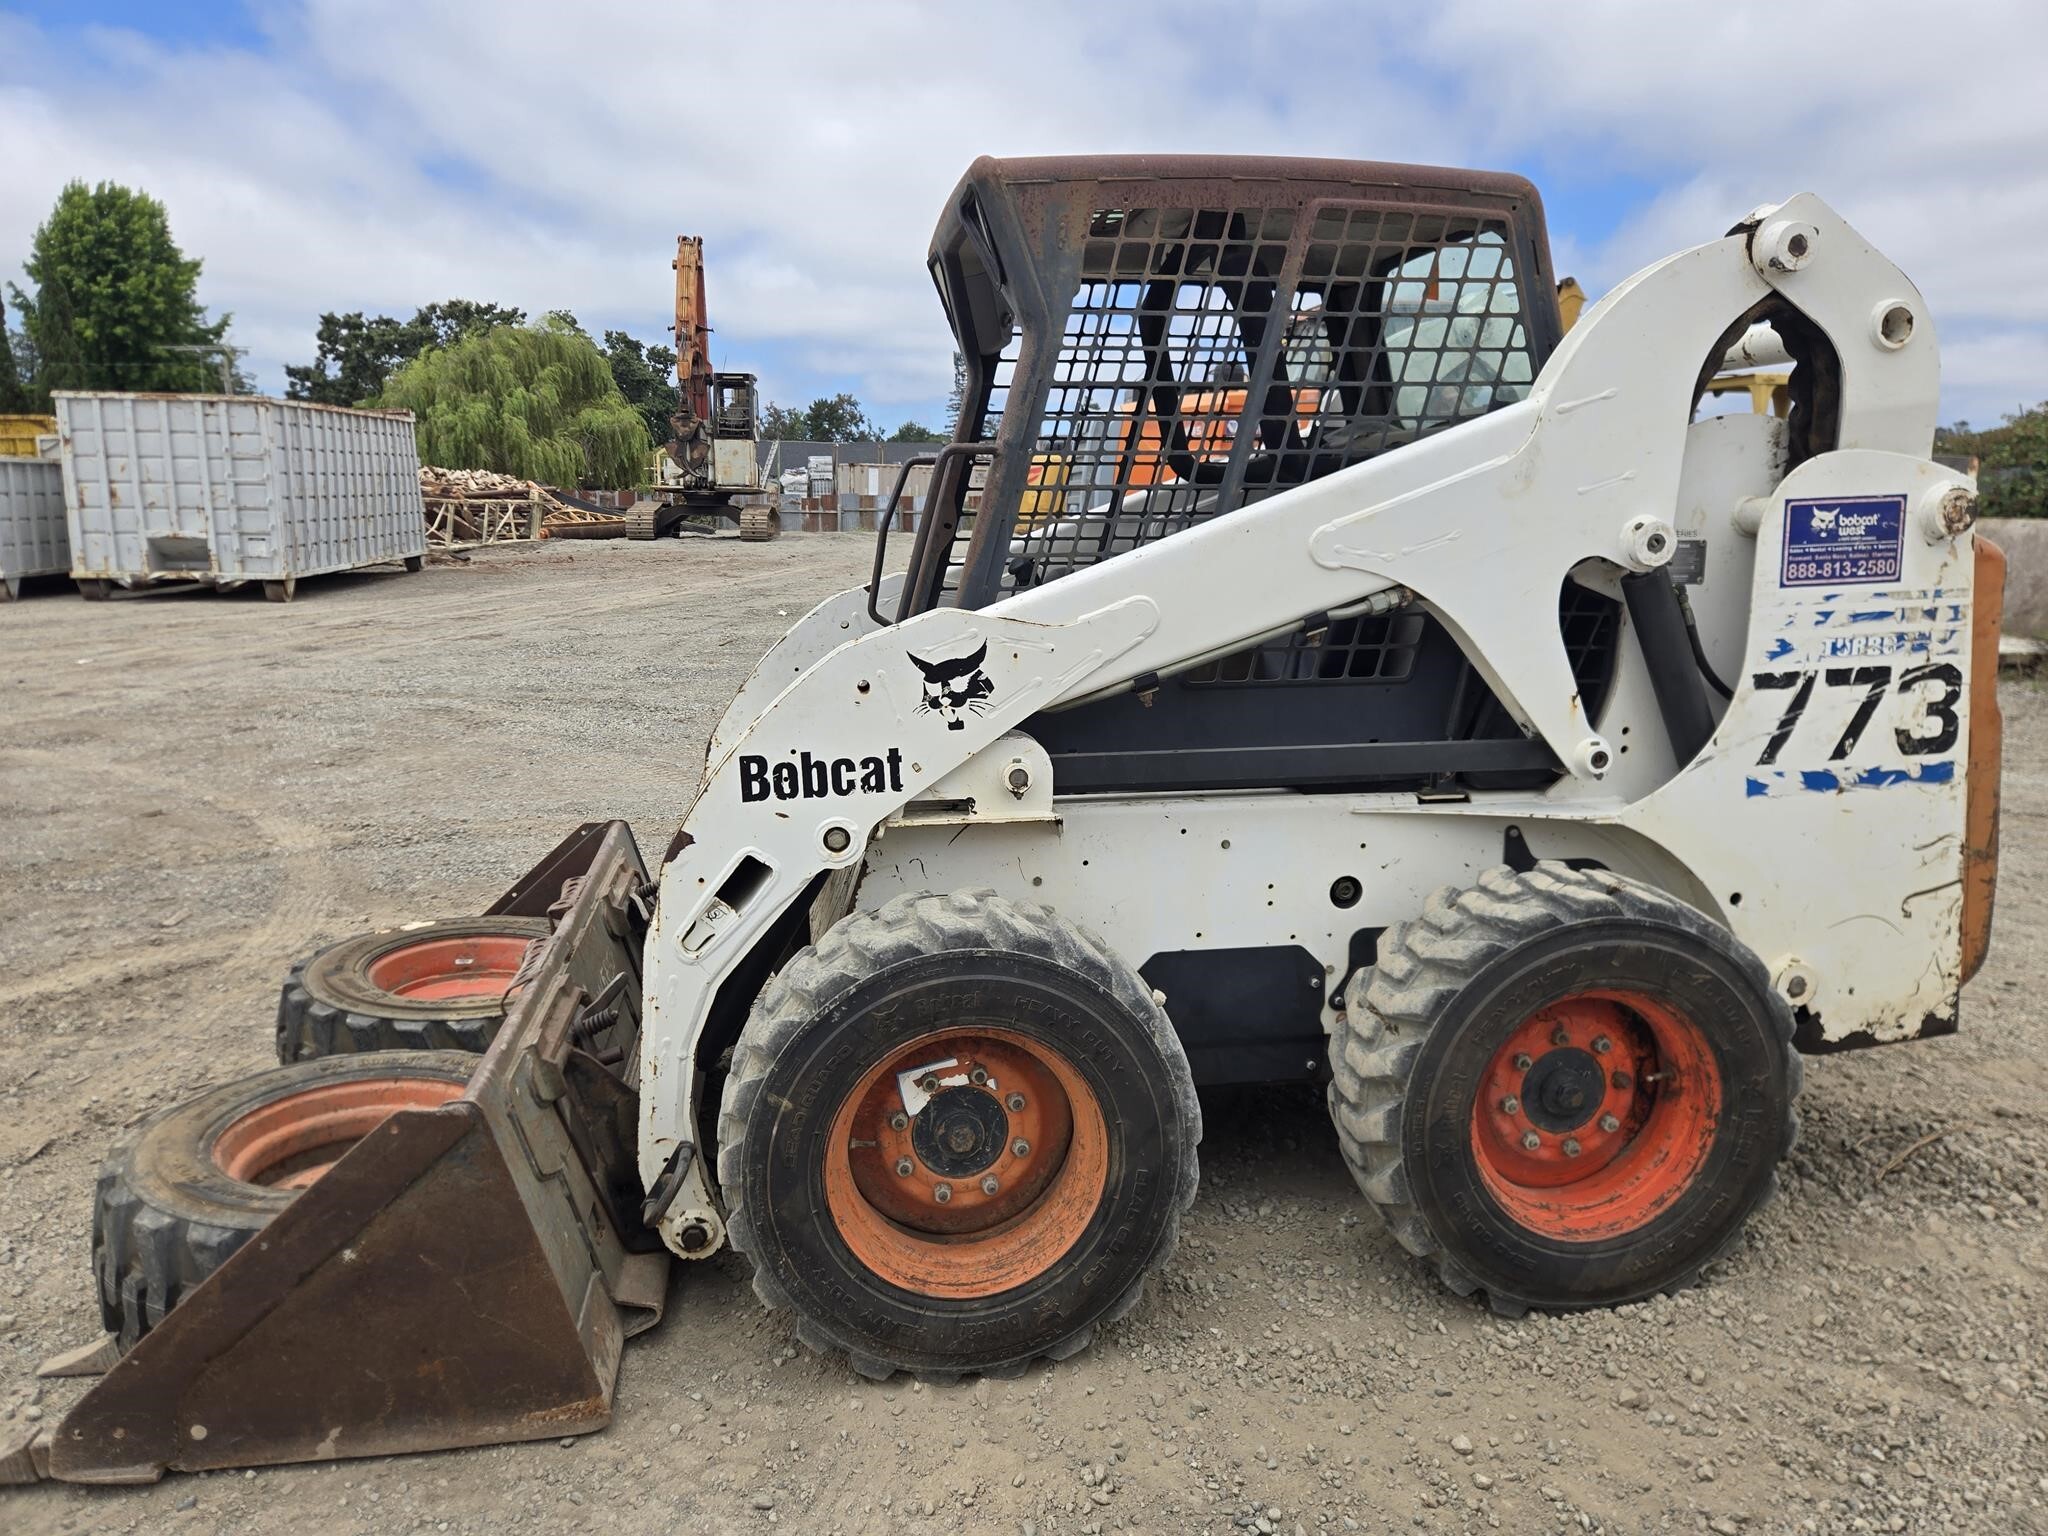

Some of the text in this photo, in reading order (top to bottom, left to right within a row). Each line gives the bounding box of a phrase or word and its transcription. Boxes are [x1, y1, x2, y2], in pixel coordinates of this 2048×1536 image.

[1839, 513, 1878, 527] bobcat
[1838, 526, 1865, 536] west
[1788, 559, 1896, 579] 888-813-2580
[1752, 663, 1963, 766] 773
[739, 748, 904, 803] Bobcat
